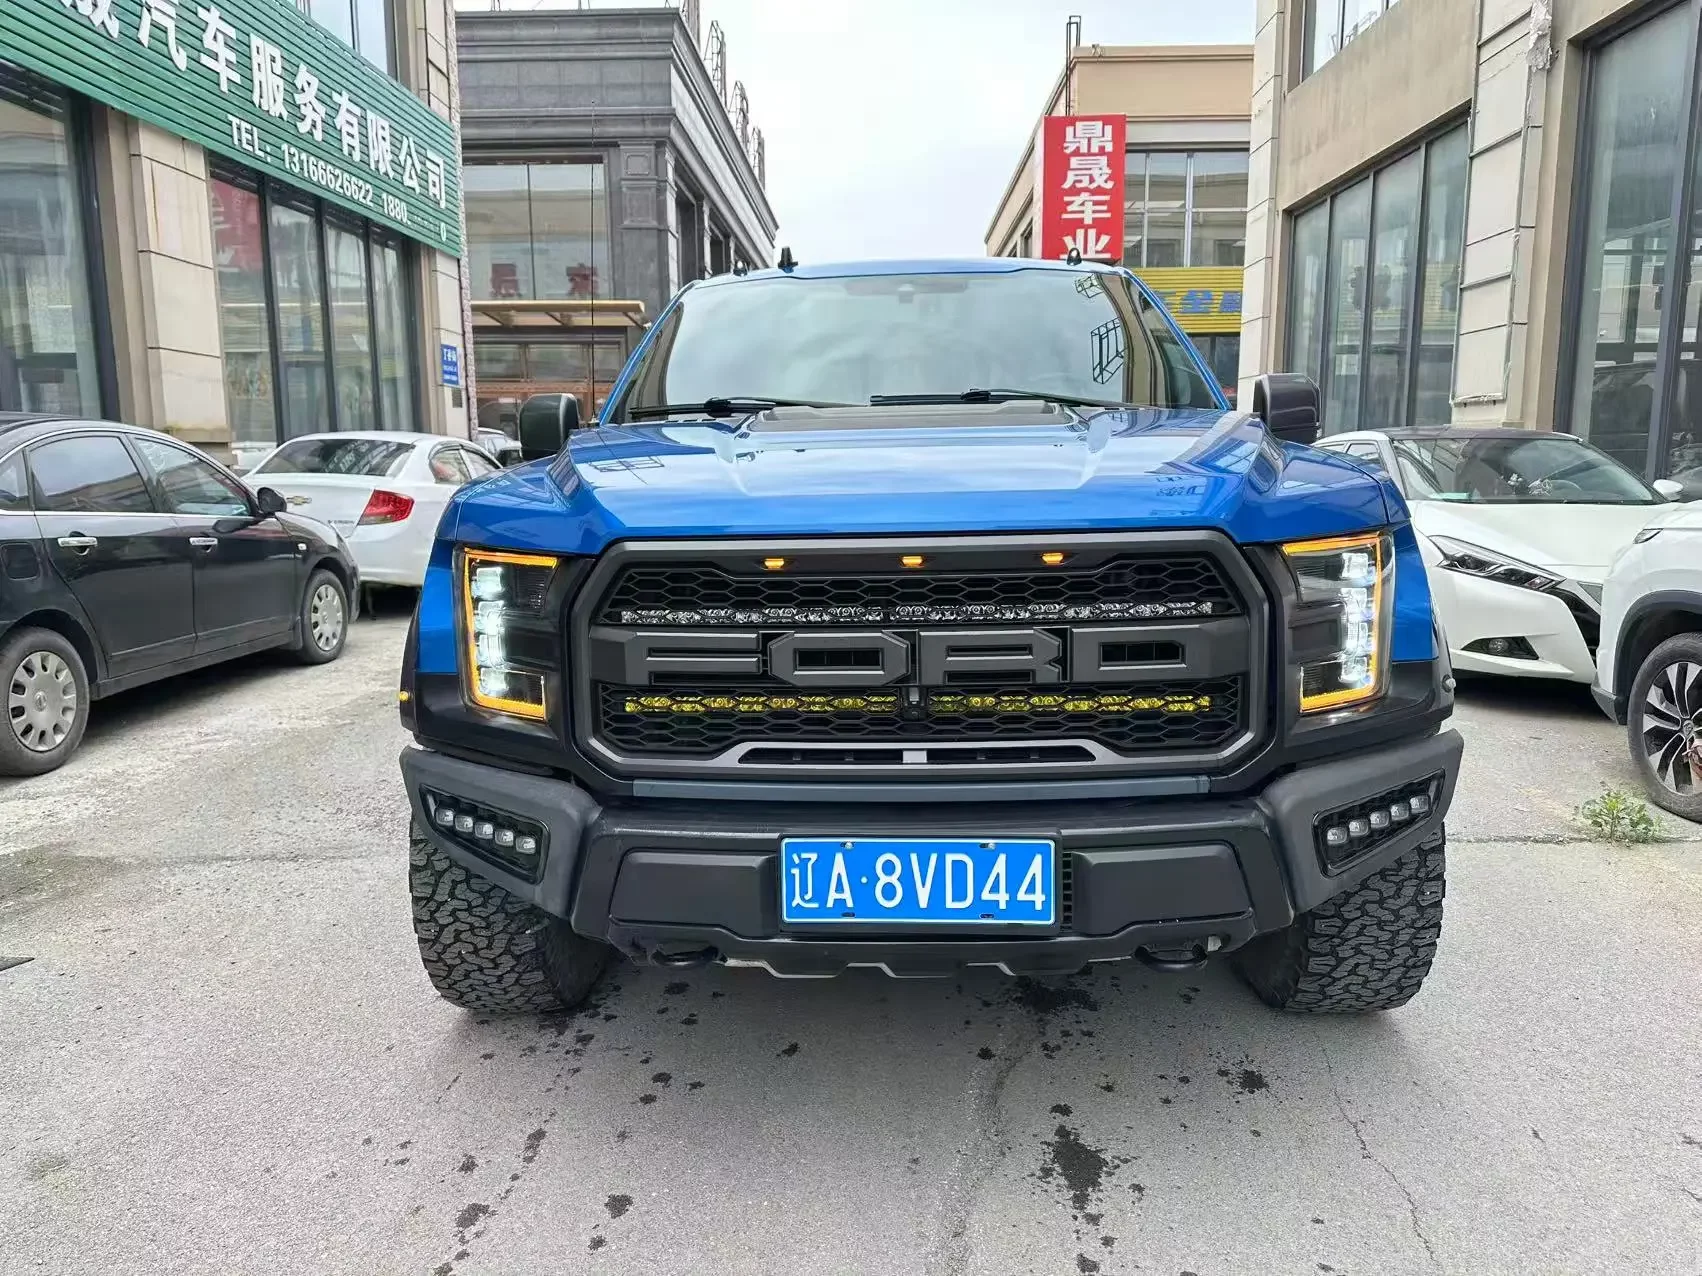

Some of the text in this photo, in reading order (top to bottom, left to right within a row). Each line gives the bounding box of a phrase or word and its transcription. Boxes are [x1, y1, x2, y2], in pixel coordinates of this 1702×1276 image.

[280, 143, 375, 208] 13166626622
[1060, 120, 1115, 260] 鼎晟车业
[626, 625, 1208, 687] FORD
[790, 852, 1046, 911] 辽A·8VD44
